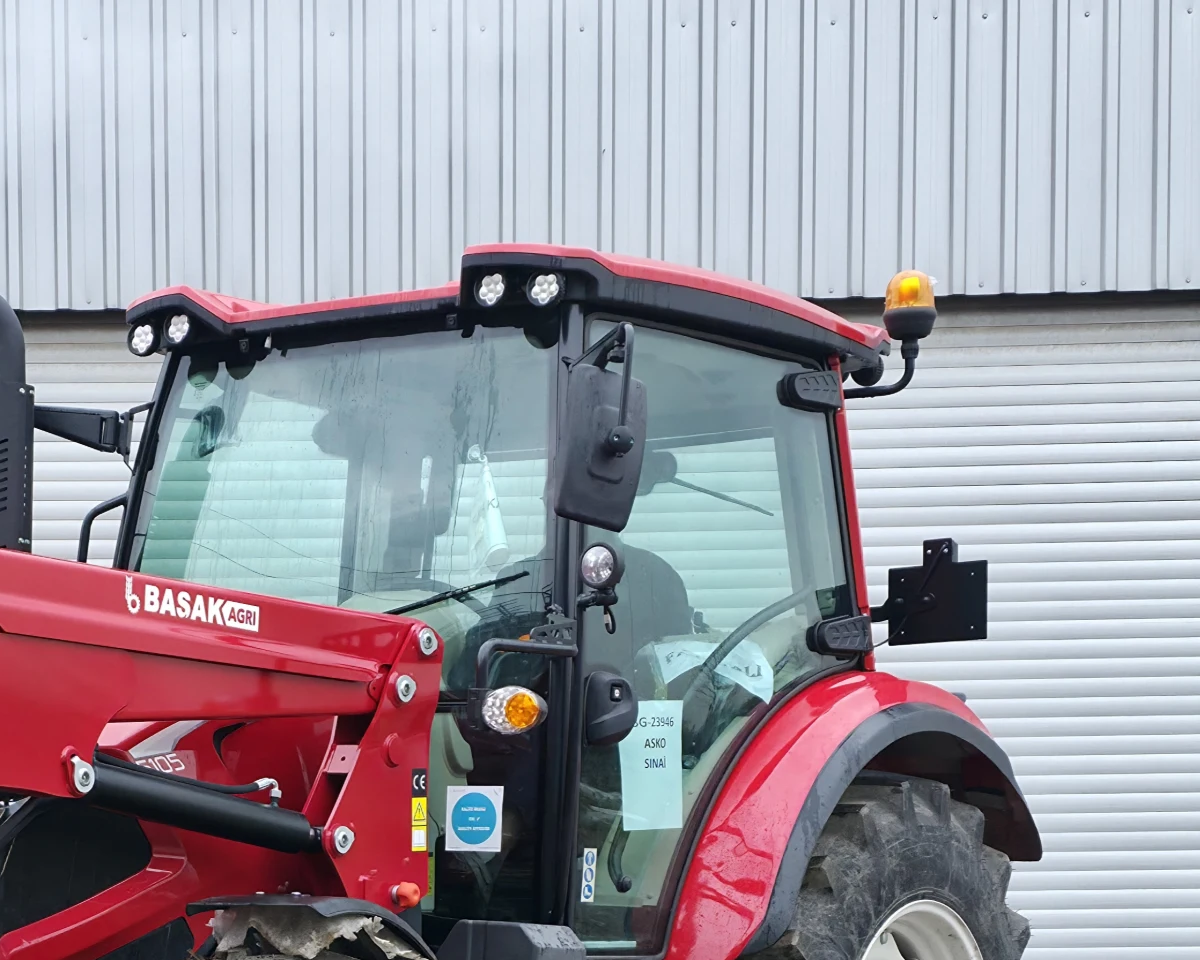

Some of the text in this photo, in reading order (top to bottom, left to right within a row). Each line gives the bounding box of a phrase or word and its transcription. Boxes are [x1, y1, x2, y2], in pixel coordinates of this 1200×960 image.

[227, 606, 257, 626] AGRI
[644, 737, 667, 749] ASKO
[412, 774, 426, 790] CE
